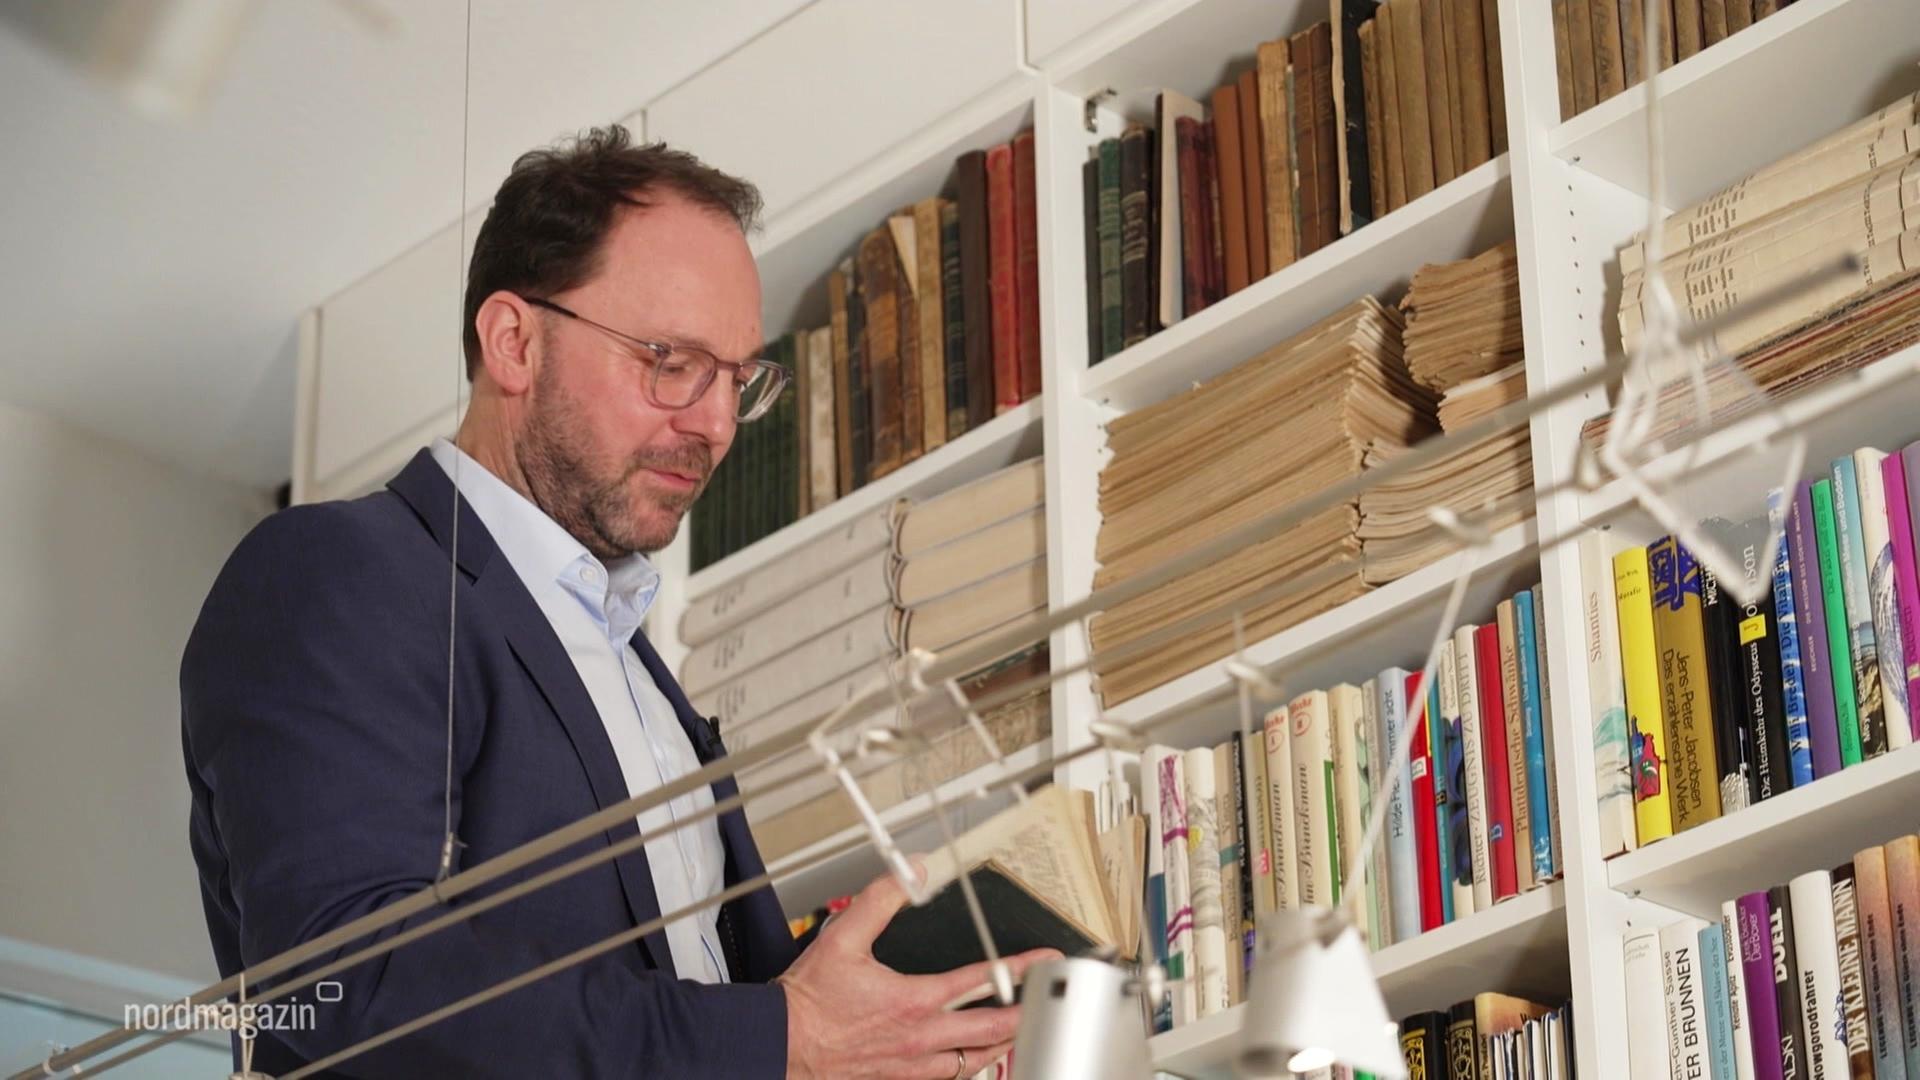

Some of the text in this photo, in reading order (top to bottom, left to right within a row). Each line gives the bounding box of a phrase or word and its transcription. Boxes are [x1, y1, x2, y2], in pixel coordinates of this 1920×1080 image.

[1833, 465, 1845, 510] Bodden
[1836, 510, 1848, 531] und
[1840, 534, 1850, 560] Meer
[1589, 591, 1602, 663] Shanties
[1802, 580, 1810, 610] MISSION
[1781, 622, 1792, 650] Die
[1750, 642, 1772, 799] Die Heimkehr des Odysseus
[1784, 662, 1799, 713] Bredel
[1502, 645, 1528, 834] Plattdeutsche Schwänke
[1663, 648, 1675, 679] Das
[1675, 779, 1690, 825] Werk
[1676, 651, 1703, 809] Jens-Peter Jacobsen
[1788, 717, 1801, 755] Willi
[1457, 652, 1487, 883] Richter ZEUGNIS ZU DRITT
[1739, 905, 1749, 938] Becker
[1769, 907, 1788, 984] DUELL
[1662, 951, 1675, 996] Sasse
[1675, 947, 1698, 1048] BRUNNEN
[1832, 878, 1869, 1057] DER KLEINE MANN
[1804, 970, 1824, 1080] Nowgorodfahrer
